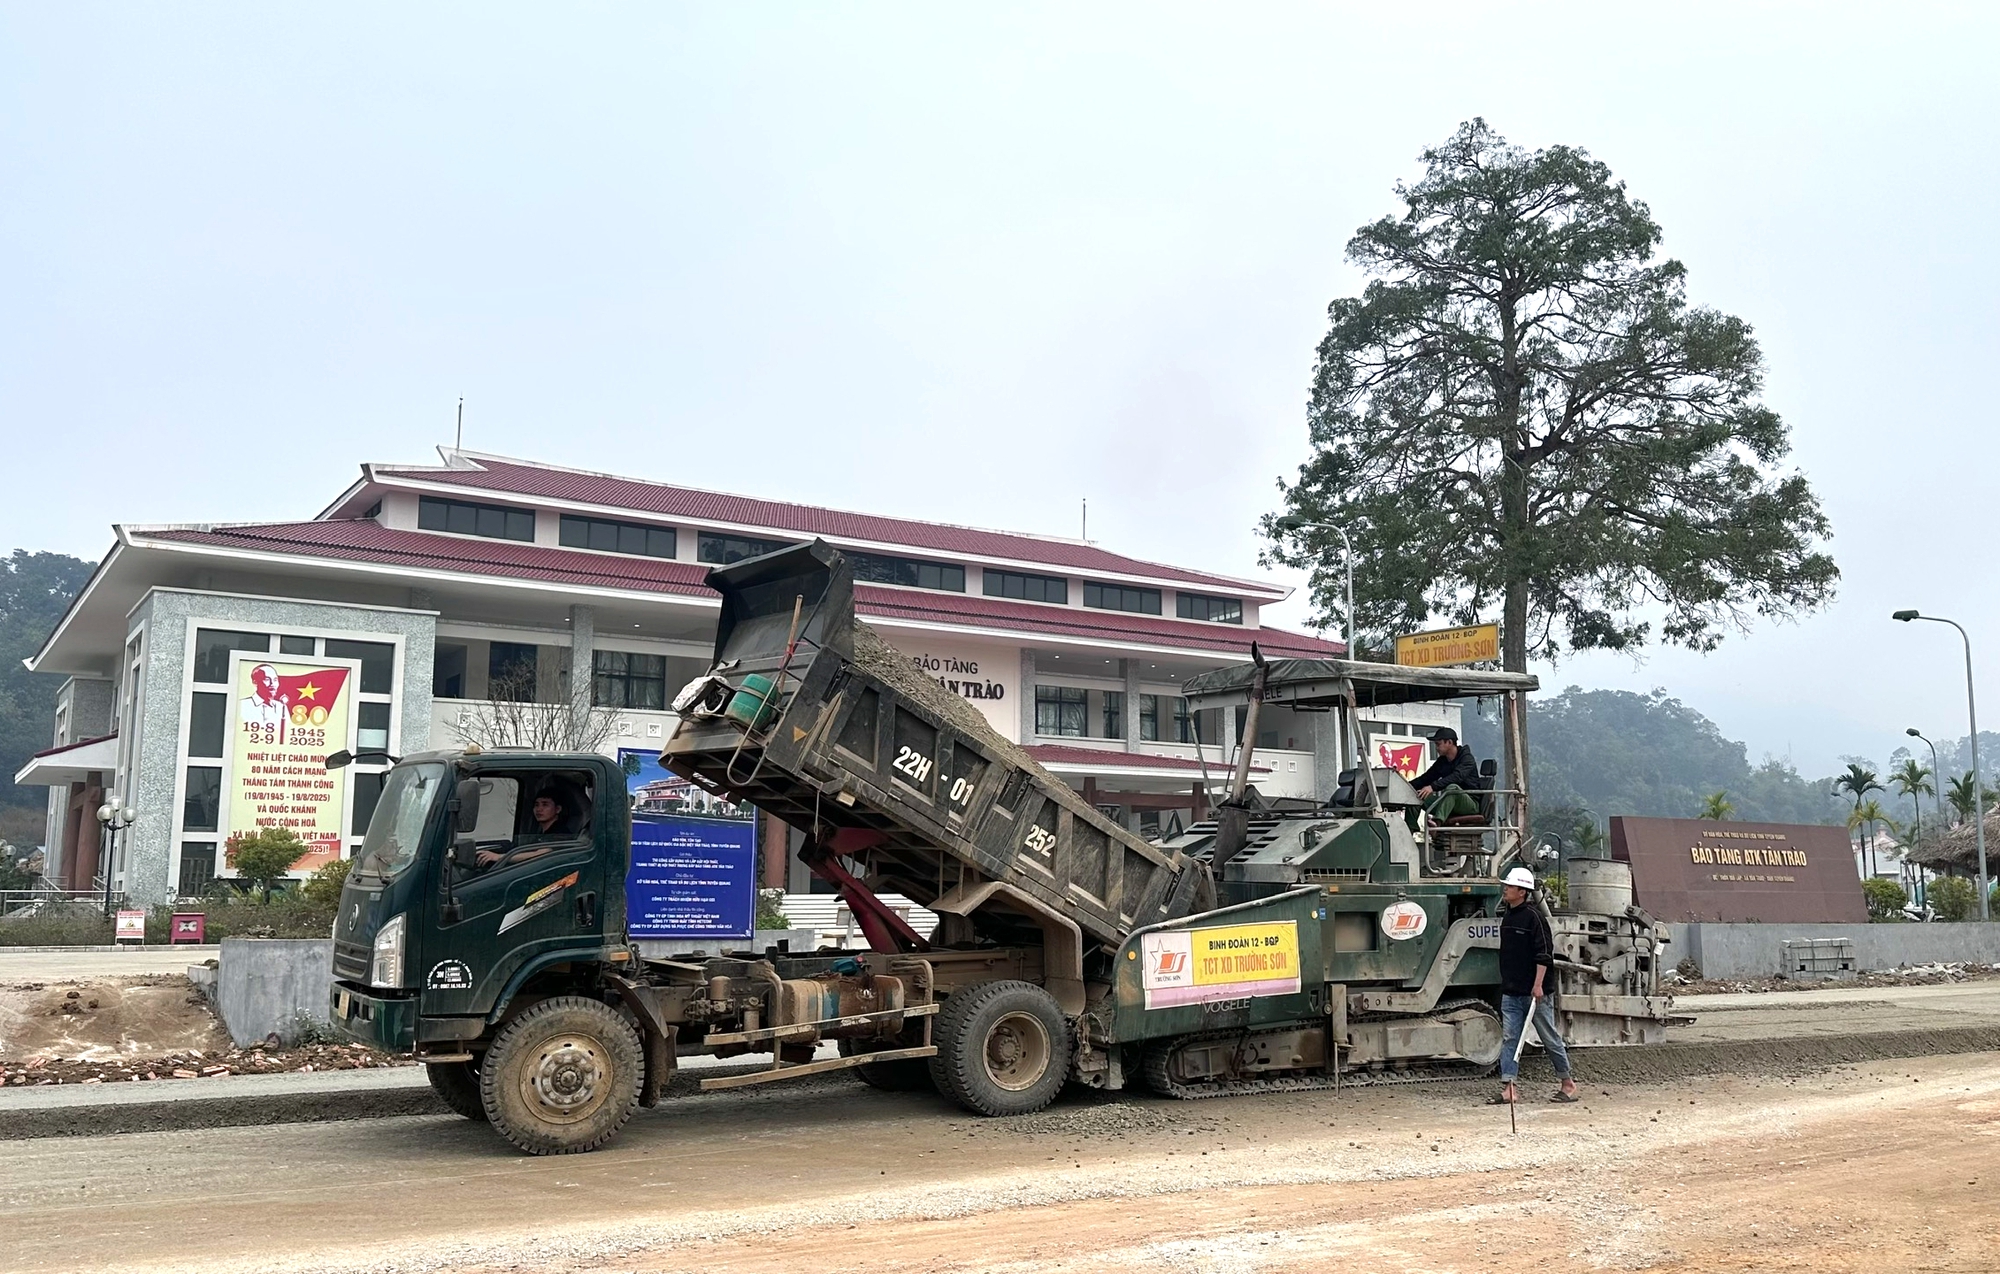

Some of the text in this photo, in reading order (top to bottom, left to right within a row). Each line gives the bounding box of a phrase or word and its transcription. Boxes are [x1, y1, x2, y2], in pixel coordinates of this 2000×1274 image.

[1401, 638, 1495, 665] TCT XD TRƯỜNG SƠN
[943, 657, 978, 674] TÀNG
[936, 676, 1004, 700] ÂN TRÀO
[290, 705, 328, 726] 80
[242, 722, 275, 733] 19-8
[290, 728, 325, 737] 1945
[249, 733, 274, 744] 2-9
[289, 737, 325, 746] 2025
[247, 751, 269, 762] NHIỆT
[271, 752, 286, 763] LIỆT
[252, 765, 261, 773] 80
[282, 765, 302, 775] CÁCH
[305, 768, 326, 777] MẠNG
[242, 777, 268, 786] THÁNG
[269, 778, 285, 787] TÁM
[314, 779, 334, 789] CÔNG
[244, 792, 284, 800] (19/8/1945
[292, 793, 330, 802] 19/8/2025)
[892, 745, 933, 783] 22H
[950, 778, 974, 807] 01
[1024, 824, 1056, 858] 252
[257, 803, 317, 814] VÀ QUỐC KHÁNH
[279, 817, 299, 827] CỘNG
[302, 831, 318, 840] VIỆT
[1691, 841, 1807, 866] BẢO TÀNG ATK TÂN TRÀO
[1468, 925, 1499, 938] SUPE
[1209, 940, 1226, 950] BINH
[1228, 936, 1250, 949] ĐOÀN
[1251, 937, 1259, 947] 12
[1203, 950, 1287, 975] TCT XD TRƯỜNG SƠN
